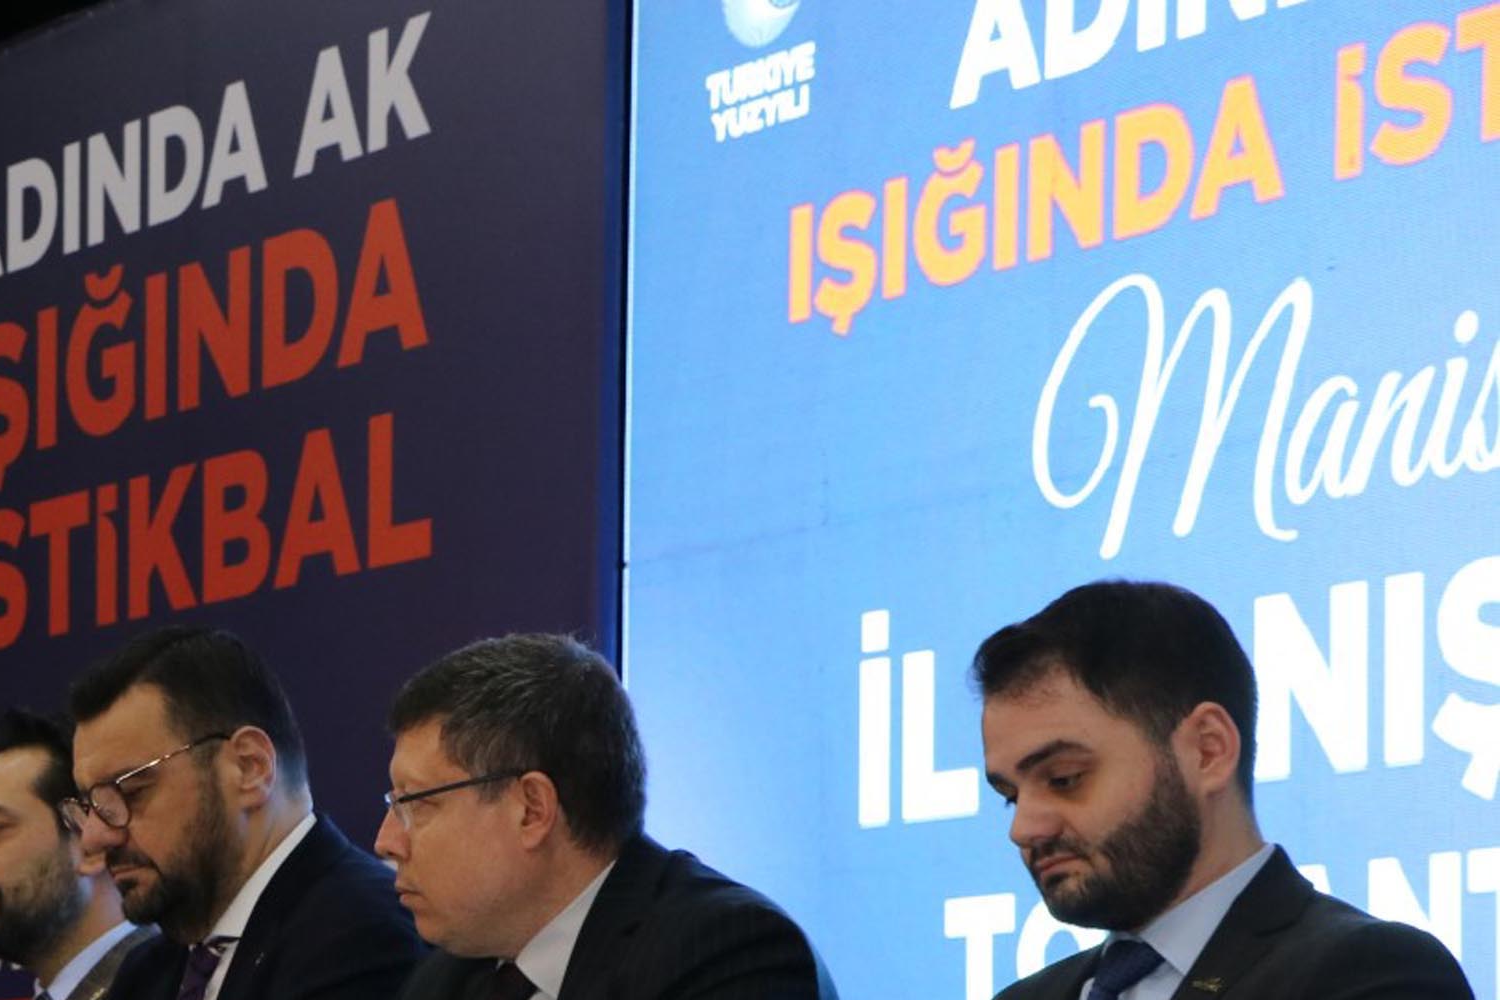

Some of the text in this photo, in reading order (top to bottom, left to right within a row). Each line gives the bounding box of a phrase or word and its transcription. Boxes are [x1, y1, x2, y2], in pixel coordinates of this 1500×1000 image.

[293, 11, 432, 179] AK
[788, 74, 1285, 336] IŞIĞINDA
[858, 610, 979, 828] İL
